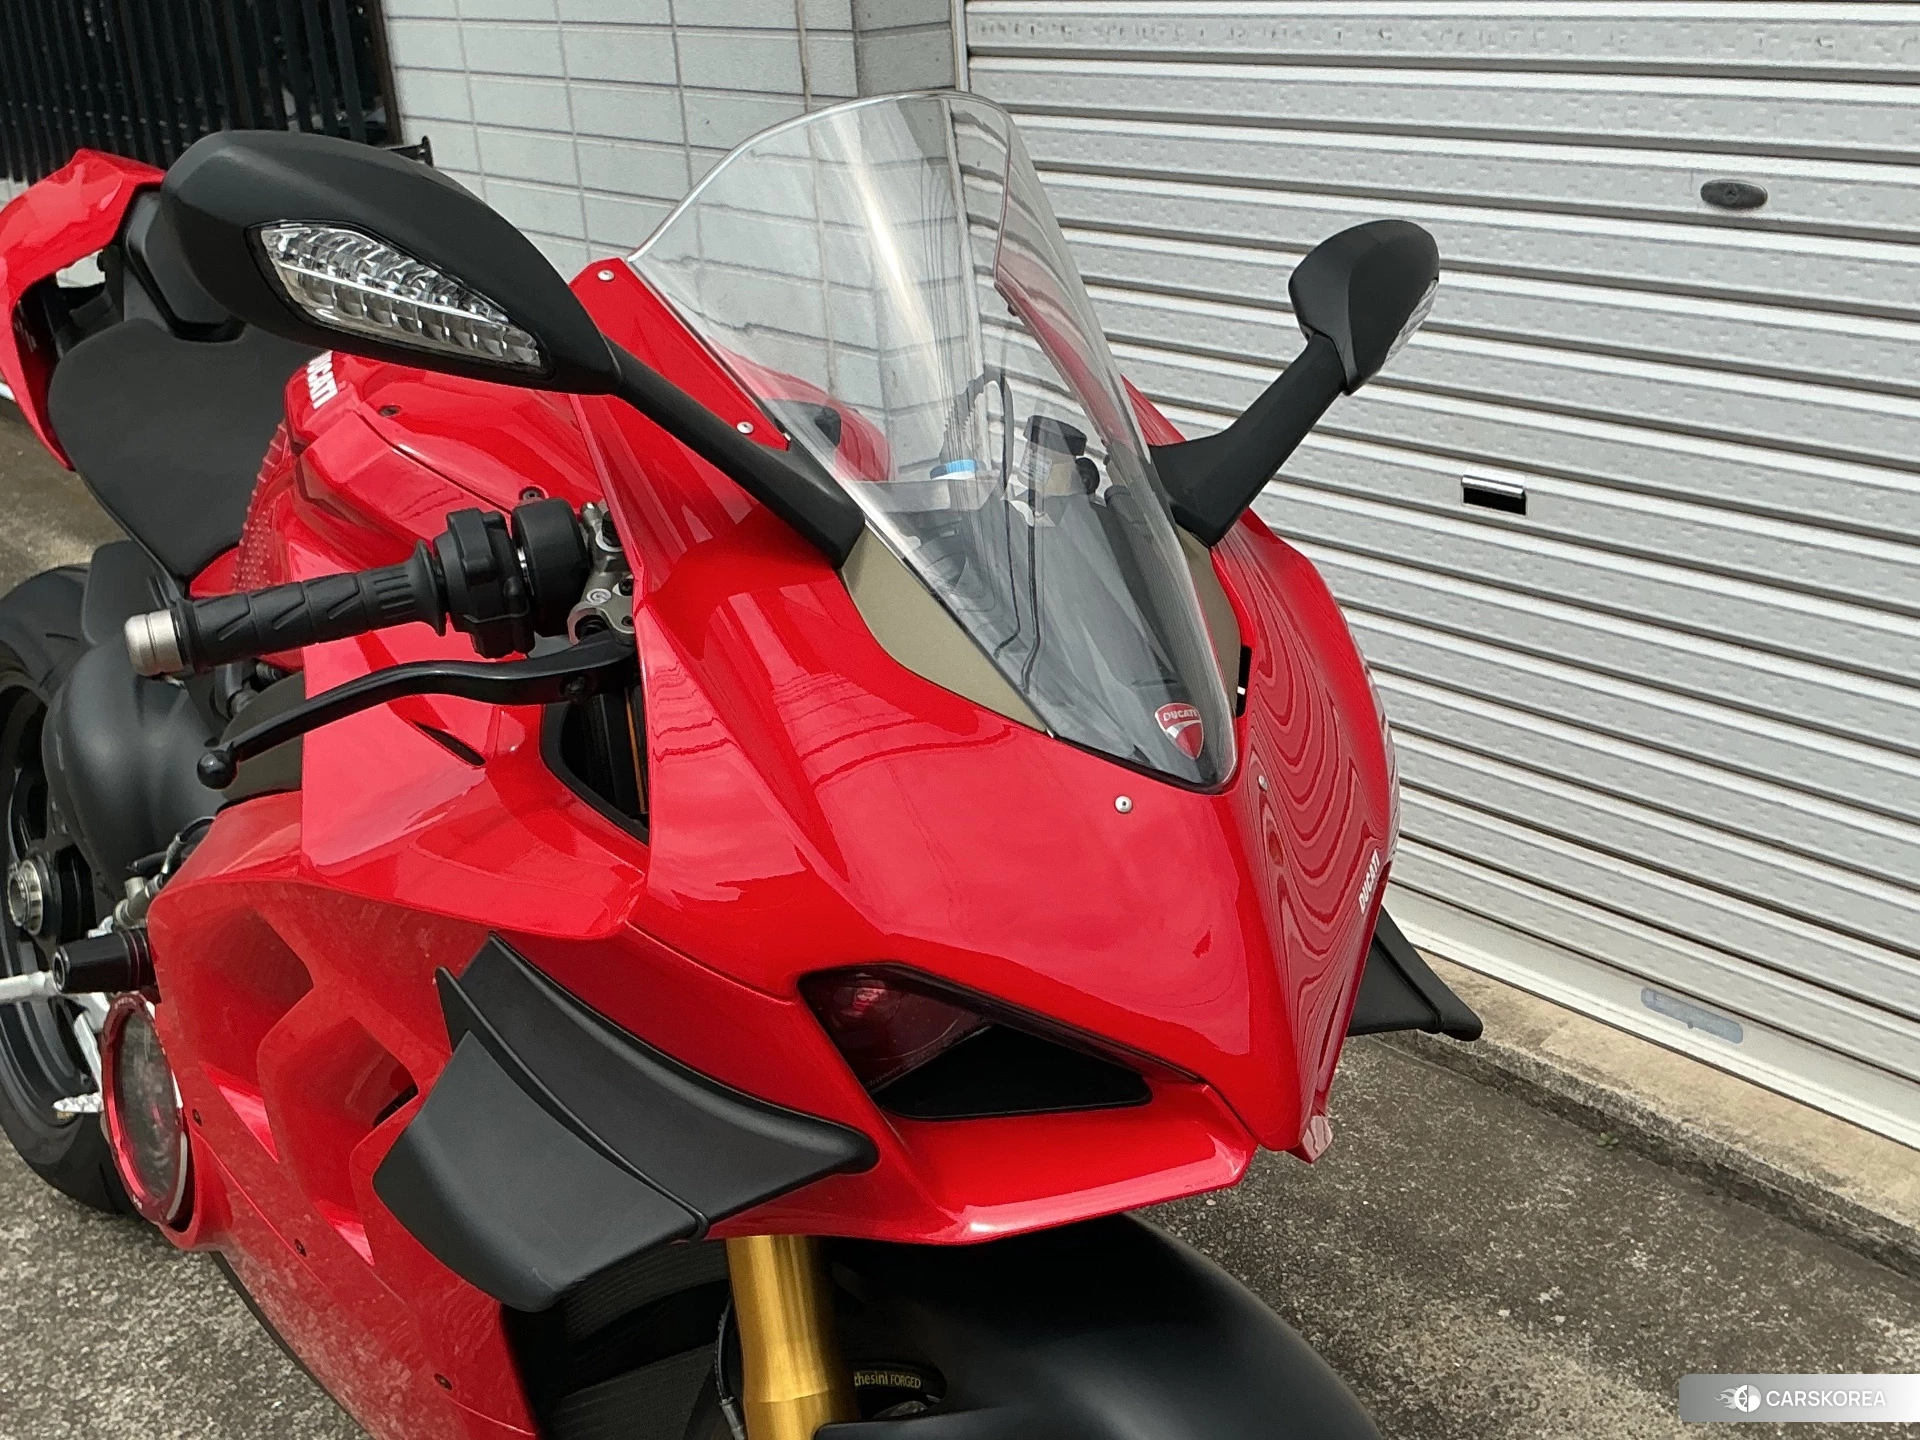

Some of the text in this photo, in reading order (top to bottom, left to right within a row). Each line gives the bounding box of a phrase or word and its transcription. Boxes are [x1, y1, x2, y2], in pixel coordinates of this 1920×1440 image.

[307, 350, 339, 409] UCATI
[1163, 709, 1198, 721] DUCATI
[1359, 849, 1380, 914] DUCATI
[890, 1374, 921, 1389] FORGED
